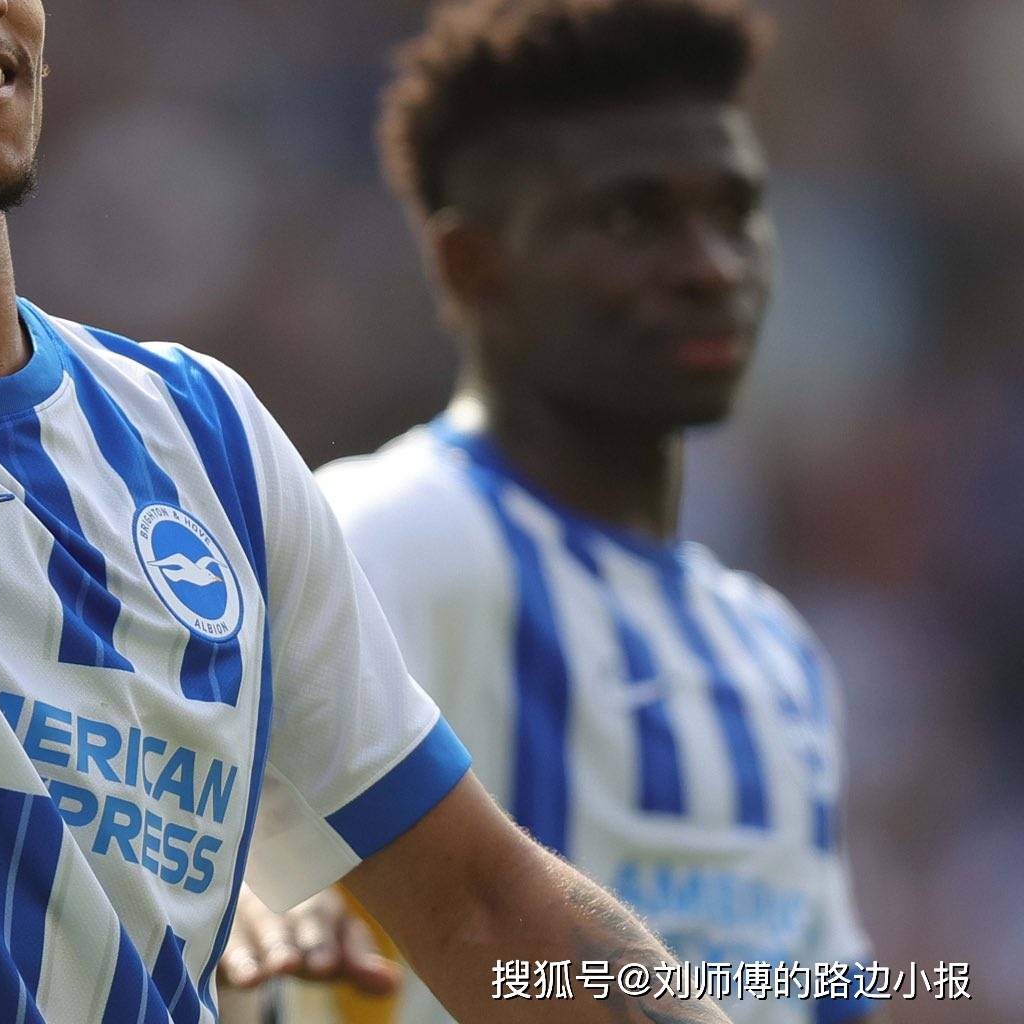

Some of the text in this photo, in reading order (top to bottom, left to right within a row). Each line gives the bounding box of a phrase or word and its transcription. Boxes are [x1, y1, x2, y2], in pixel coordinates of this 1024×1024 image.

[140, 507, 169, 540] BRIGHTON
[184, 519, 212, 546] HOVE
[194, 619, 229, 634] ALBION
[41, 777, 223, 894] PRESS
